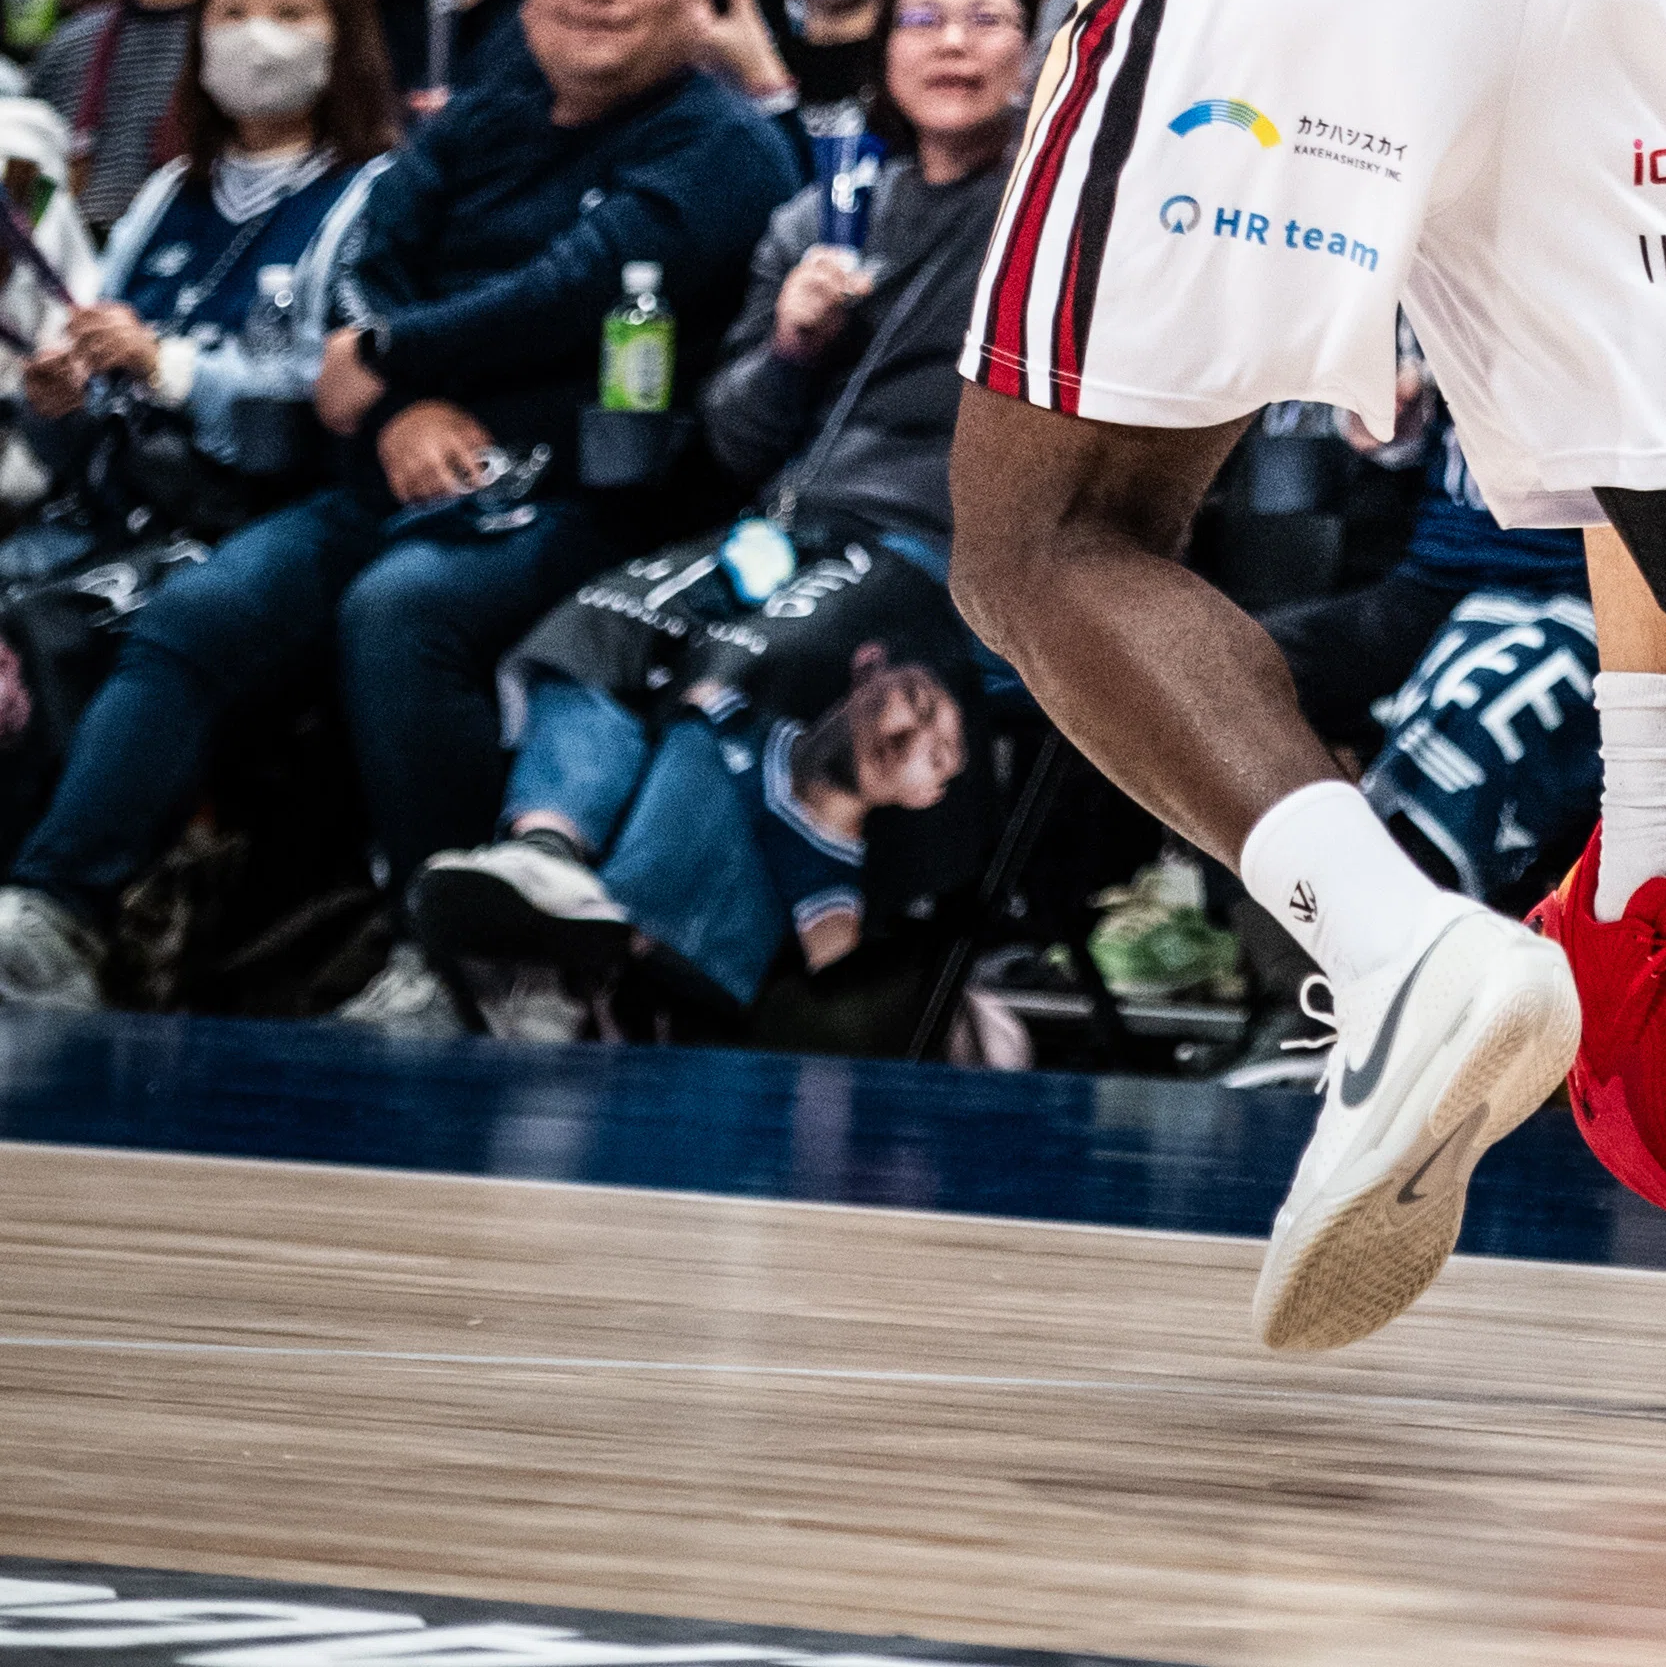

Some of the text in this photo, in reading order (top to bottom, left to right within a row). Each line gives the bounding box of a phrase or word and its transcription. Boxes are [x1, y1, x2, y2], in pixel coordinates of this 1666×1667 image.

[1294, 144, 1380, 174] KAKEHASHISKY
[1297, 115, 1408, 161] カケハシスカイ
[1214, 207, 1379, 272] HR team
